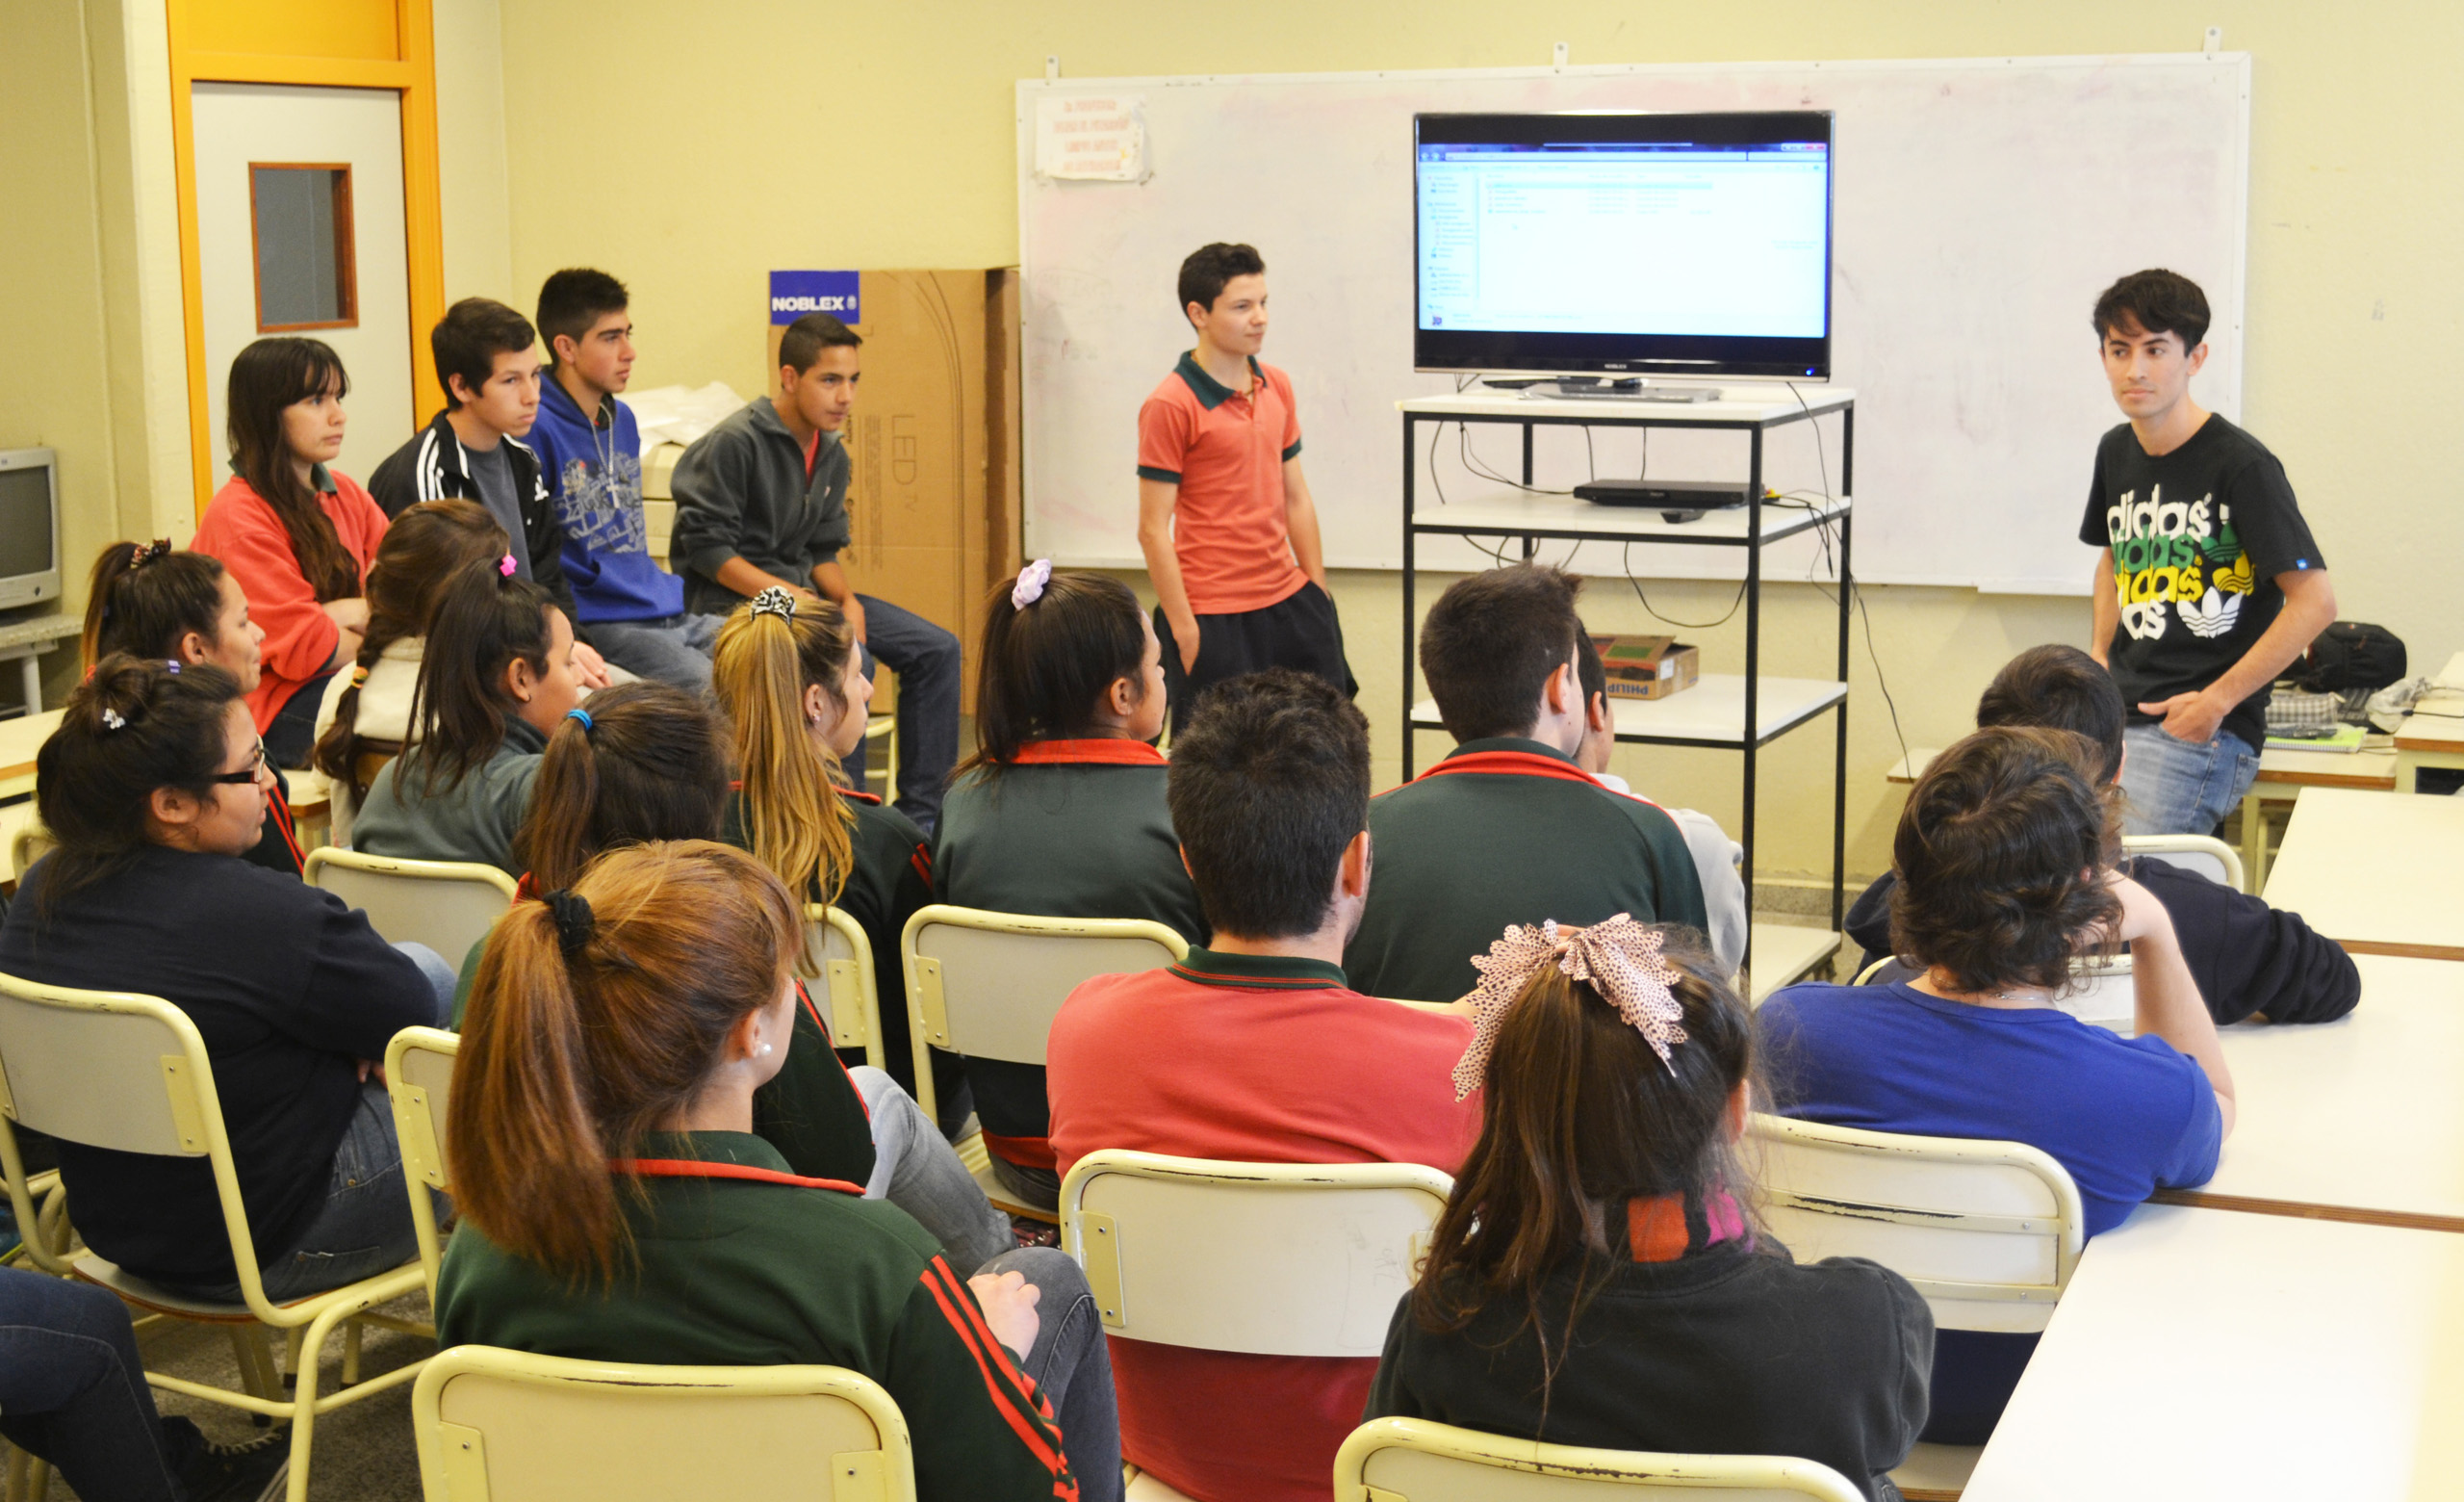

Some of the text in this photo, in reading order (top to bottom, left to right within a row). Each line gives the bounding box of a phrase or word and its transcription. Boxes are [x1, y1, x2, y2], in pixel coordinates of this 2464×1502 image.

[771, 296, 844, 311] NOBLEX
[891, 414, 916, 485] LED
[1606, 683, 1649, 695] PHILIP
